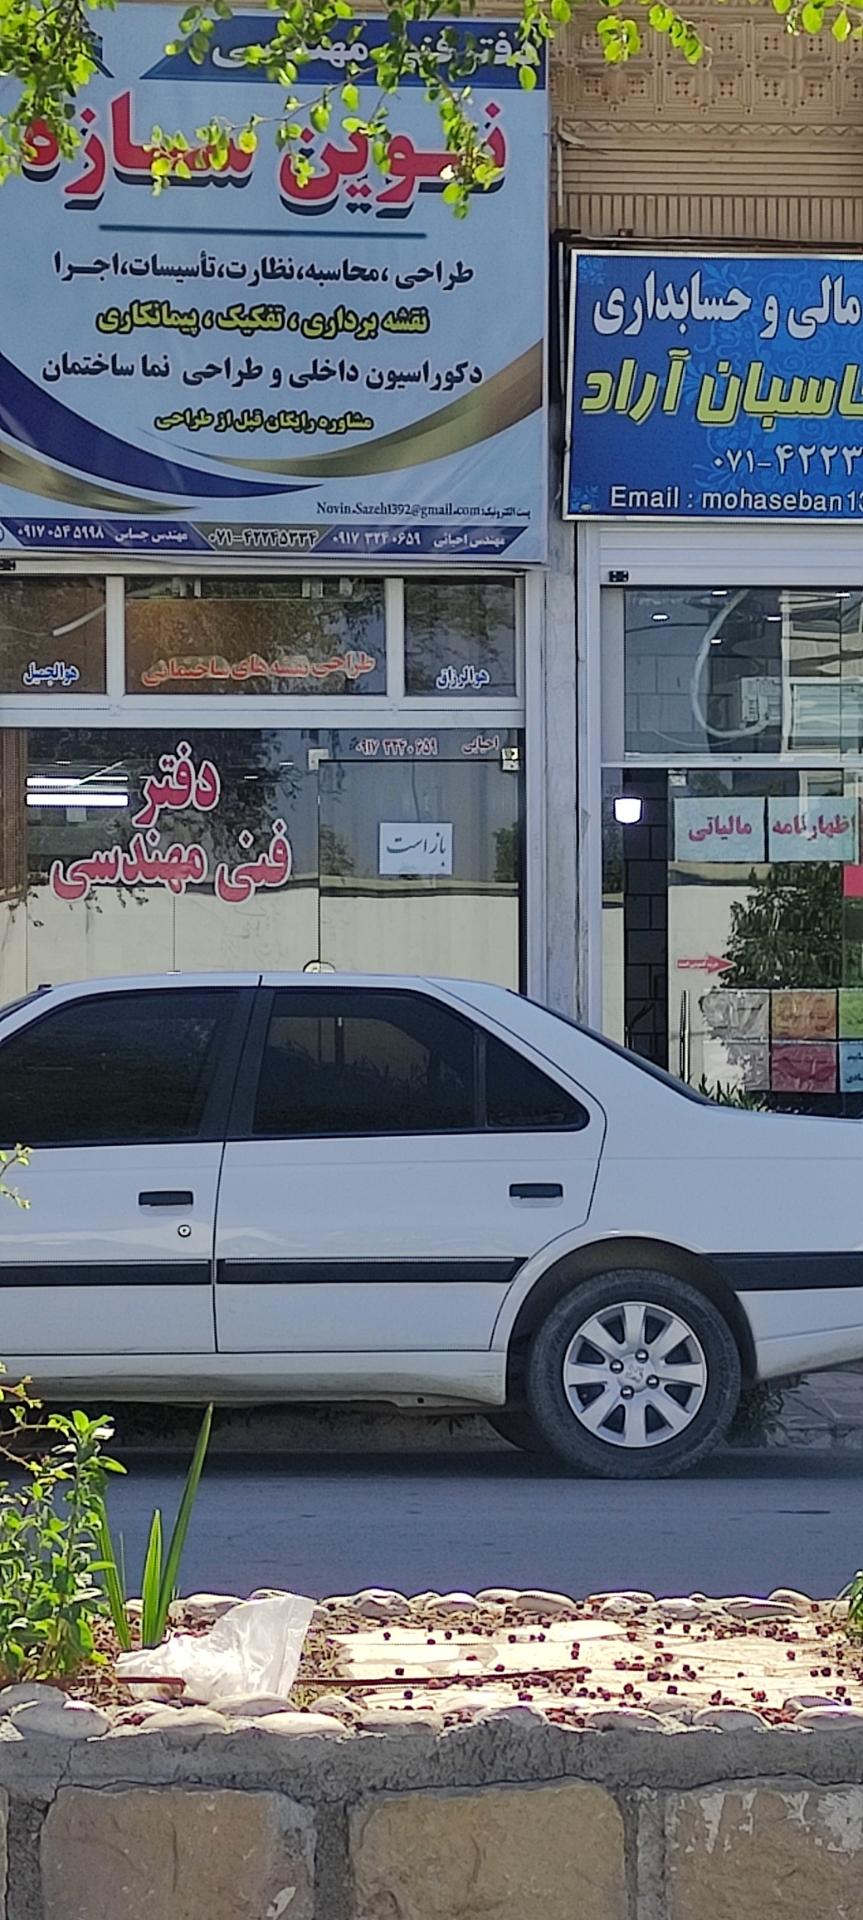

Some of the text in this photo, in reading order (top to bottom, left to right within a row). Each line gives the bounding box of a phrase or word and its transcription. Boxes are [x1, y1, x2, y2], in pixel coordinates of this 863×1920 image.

[395, 260, 474, 290] طراحی
[96, 301, 201, 337] پیمانکاری
[217, 303, 285, 335] تفکیک
[382, 306, 430, 333] نقشه
[593, 270, 862, 339] مالی و حسابداری
[303, 305, 379, 340] برداری
[42, 351, 483, 391] دکوراسیون داخلی و طراحی نما ساختمان
[581, 348, 692, 425] آراد
[155, 408, 213, 431] طراحی
[214, 409, 233, 432] از
[234, 409, 263, 432] قبل
[317, 412, 374, 434] مشاوره
[610, 486, 679, 508] Email
[151, 529, 188, 543] مهندس
[310, 651, 376, 680] طراحی
[132, 741, 220, 828] دفتر
[688, 813, 855, 841] اظهارنامه مالیاتی
[50, 818, 293, 903] فنی مهندسی
[386, 831, 447, 867] باز است
